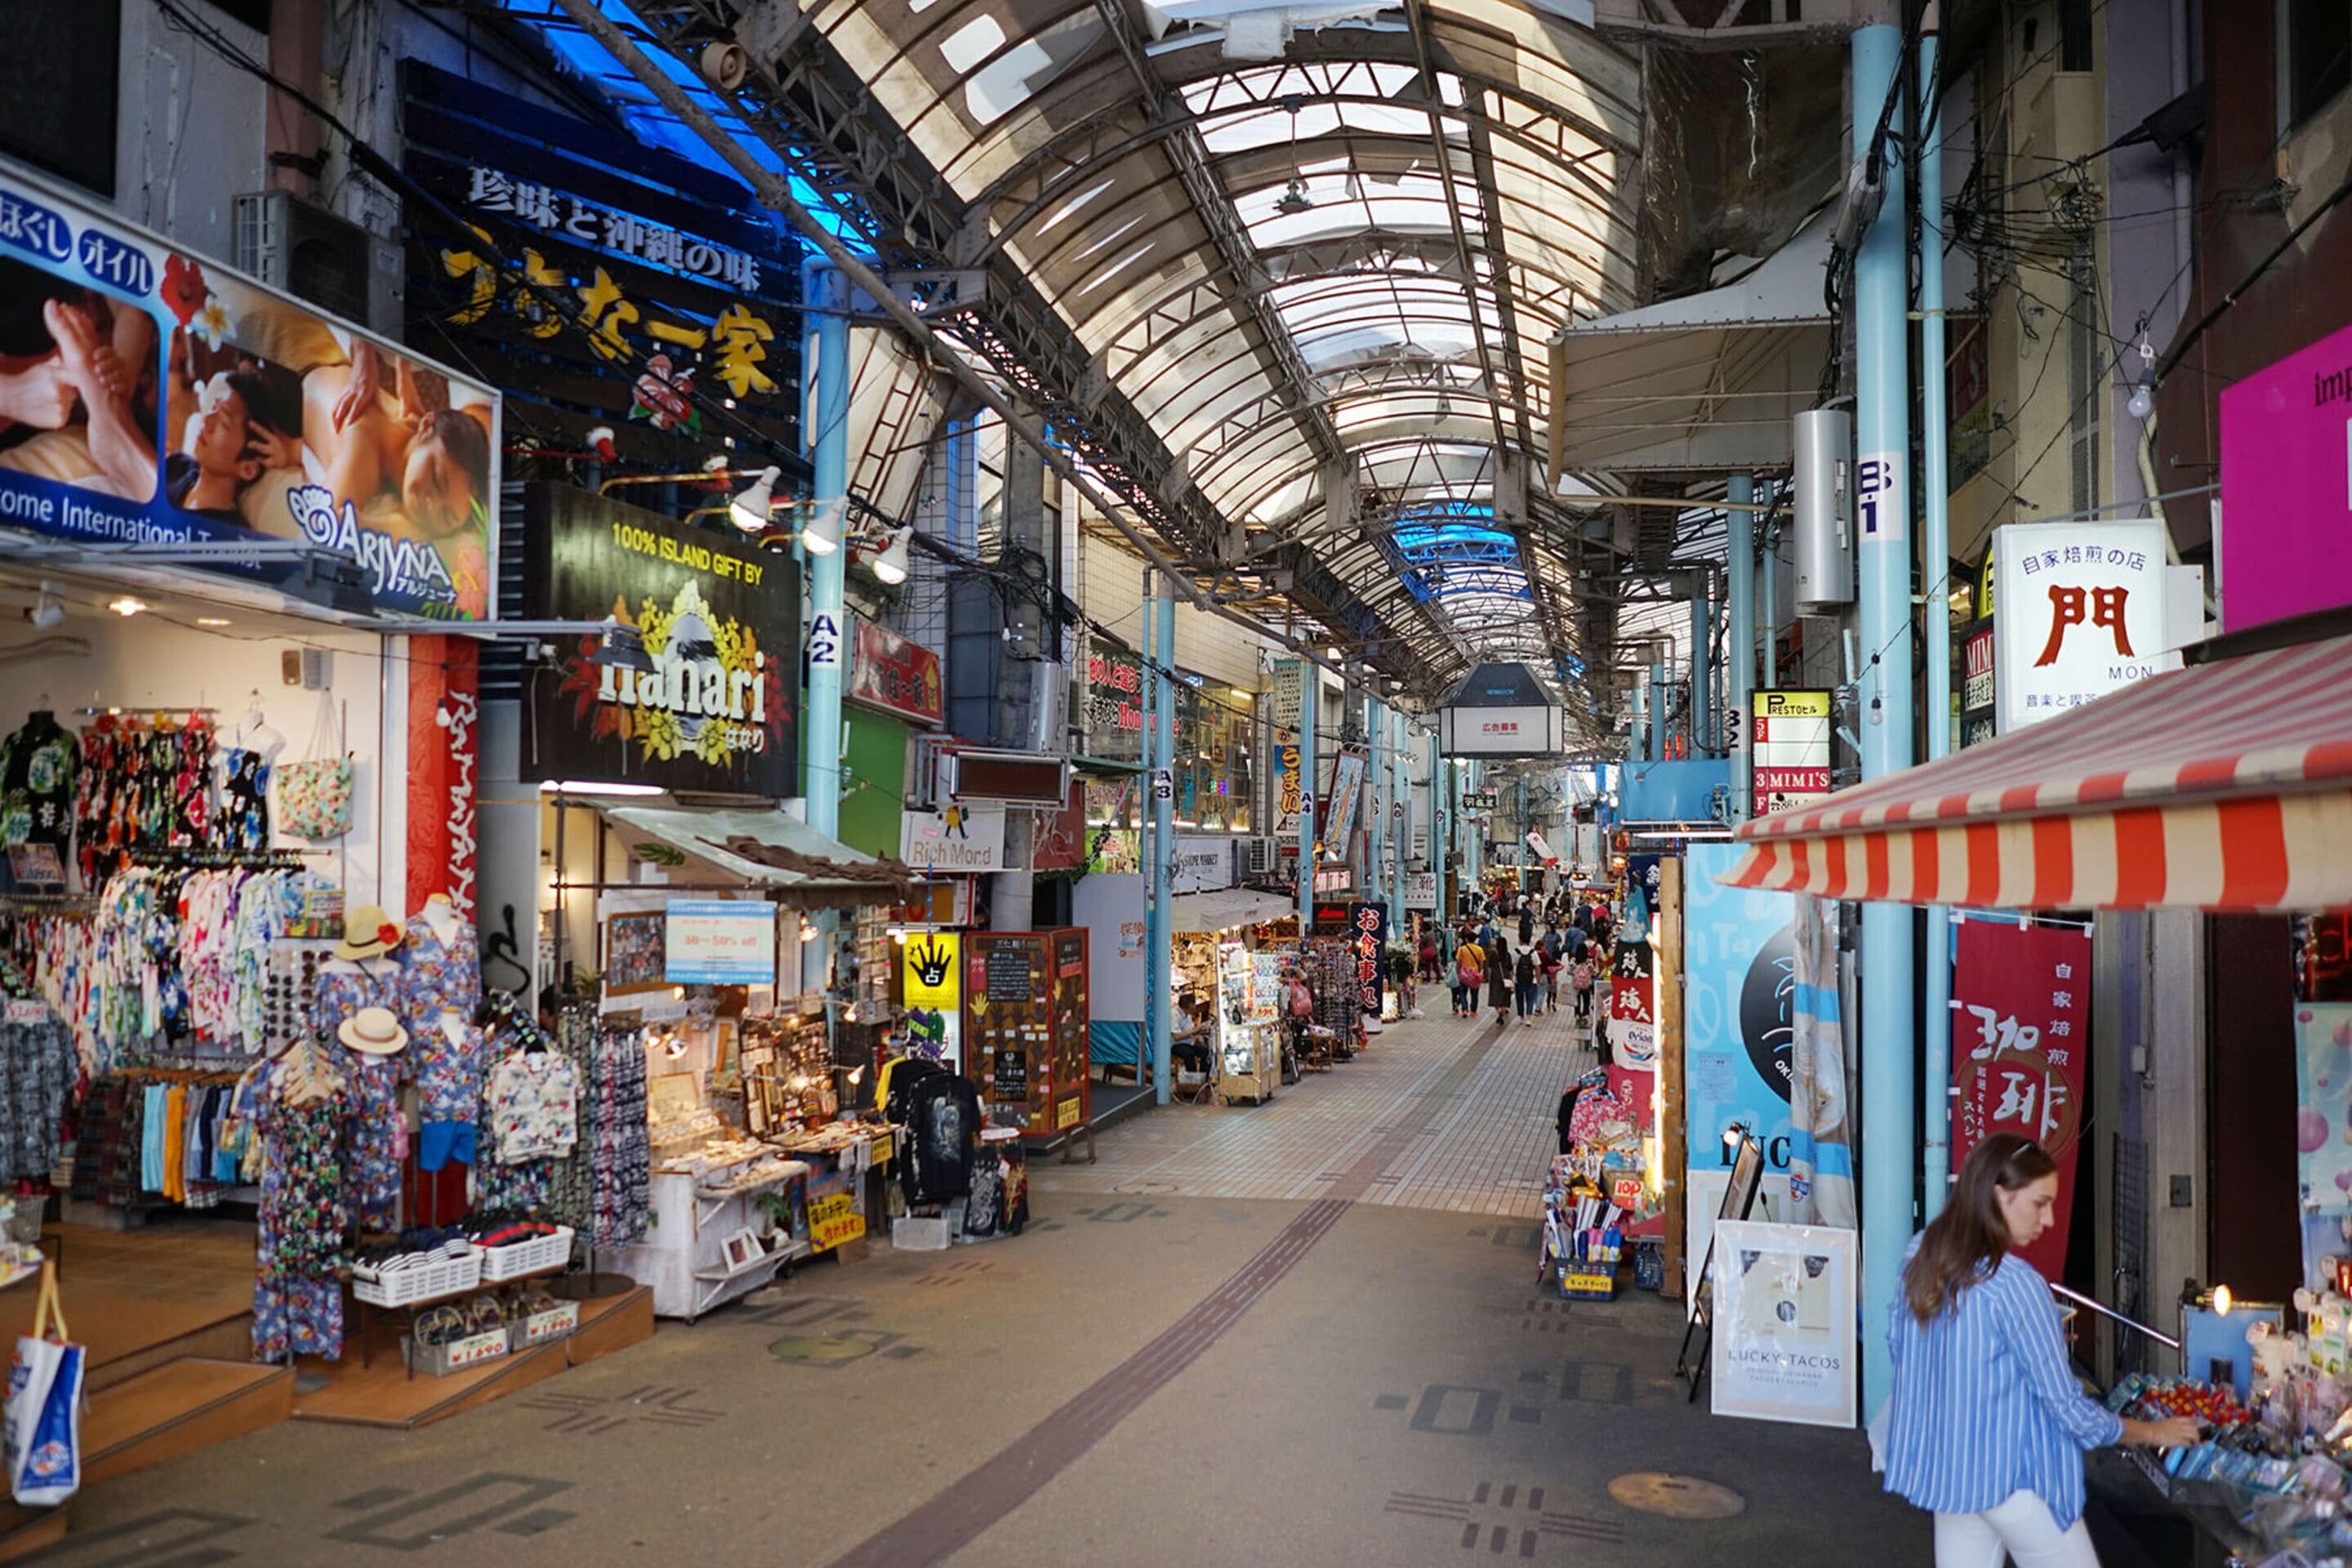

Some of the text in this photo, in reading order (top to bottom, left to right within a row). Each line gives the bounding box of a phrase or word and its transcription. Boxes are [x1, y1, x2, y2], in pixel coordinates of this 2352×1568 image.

[469, 165, 760, 292] 珍味と沖縄の味
[82, 237, 151, 292] オイル
[0, 492, 192, 546] ome International
[612, 522, 763, 586] 100% ISLAND GIFT BY
[2022, 546, 2147, 575] 自家焙煎の店
[397, 577, 457, 603] アルジューナ
[2034, 585, 2136, 669] 門
[2109, 666, 2154, 679] MON
[1482, 722, 1518, 733] 広告募集
[1769, 772, 1829, 788] MIMI'S
[913, 840, 948, 865] Rich
[1419, 875, 1436, 891] 靴
[1357, 907, 1379, 1008] お食事処
[924, 966, 941, 984] 占
[2047, 963, 2072, 1067] 自家焙煎
[1775, 1059, 1794, 1084] OKI
[1967, 1004, 2068, 1140] 珈琲
[1728, 1349, 1840, 1370] LUCKY TACOS
